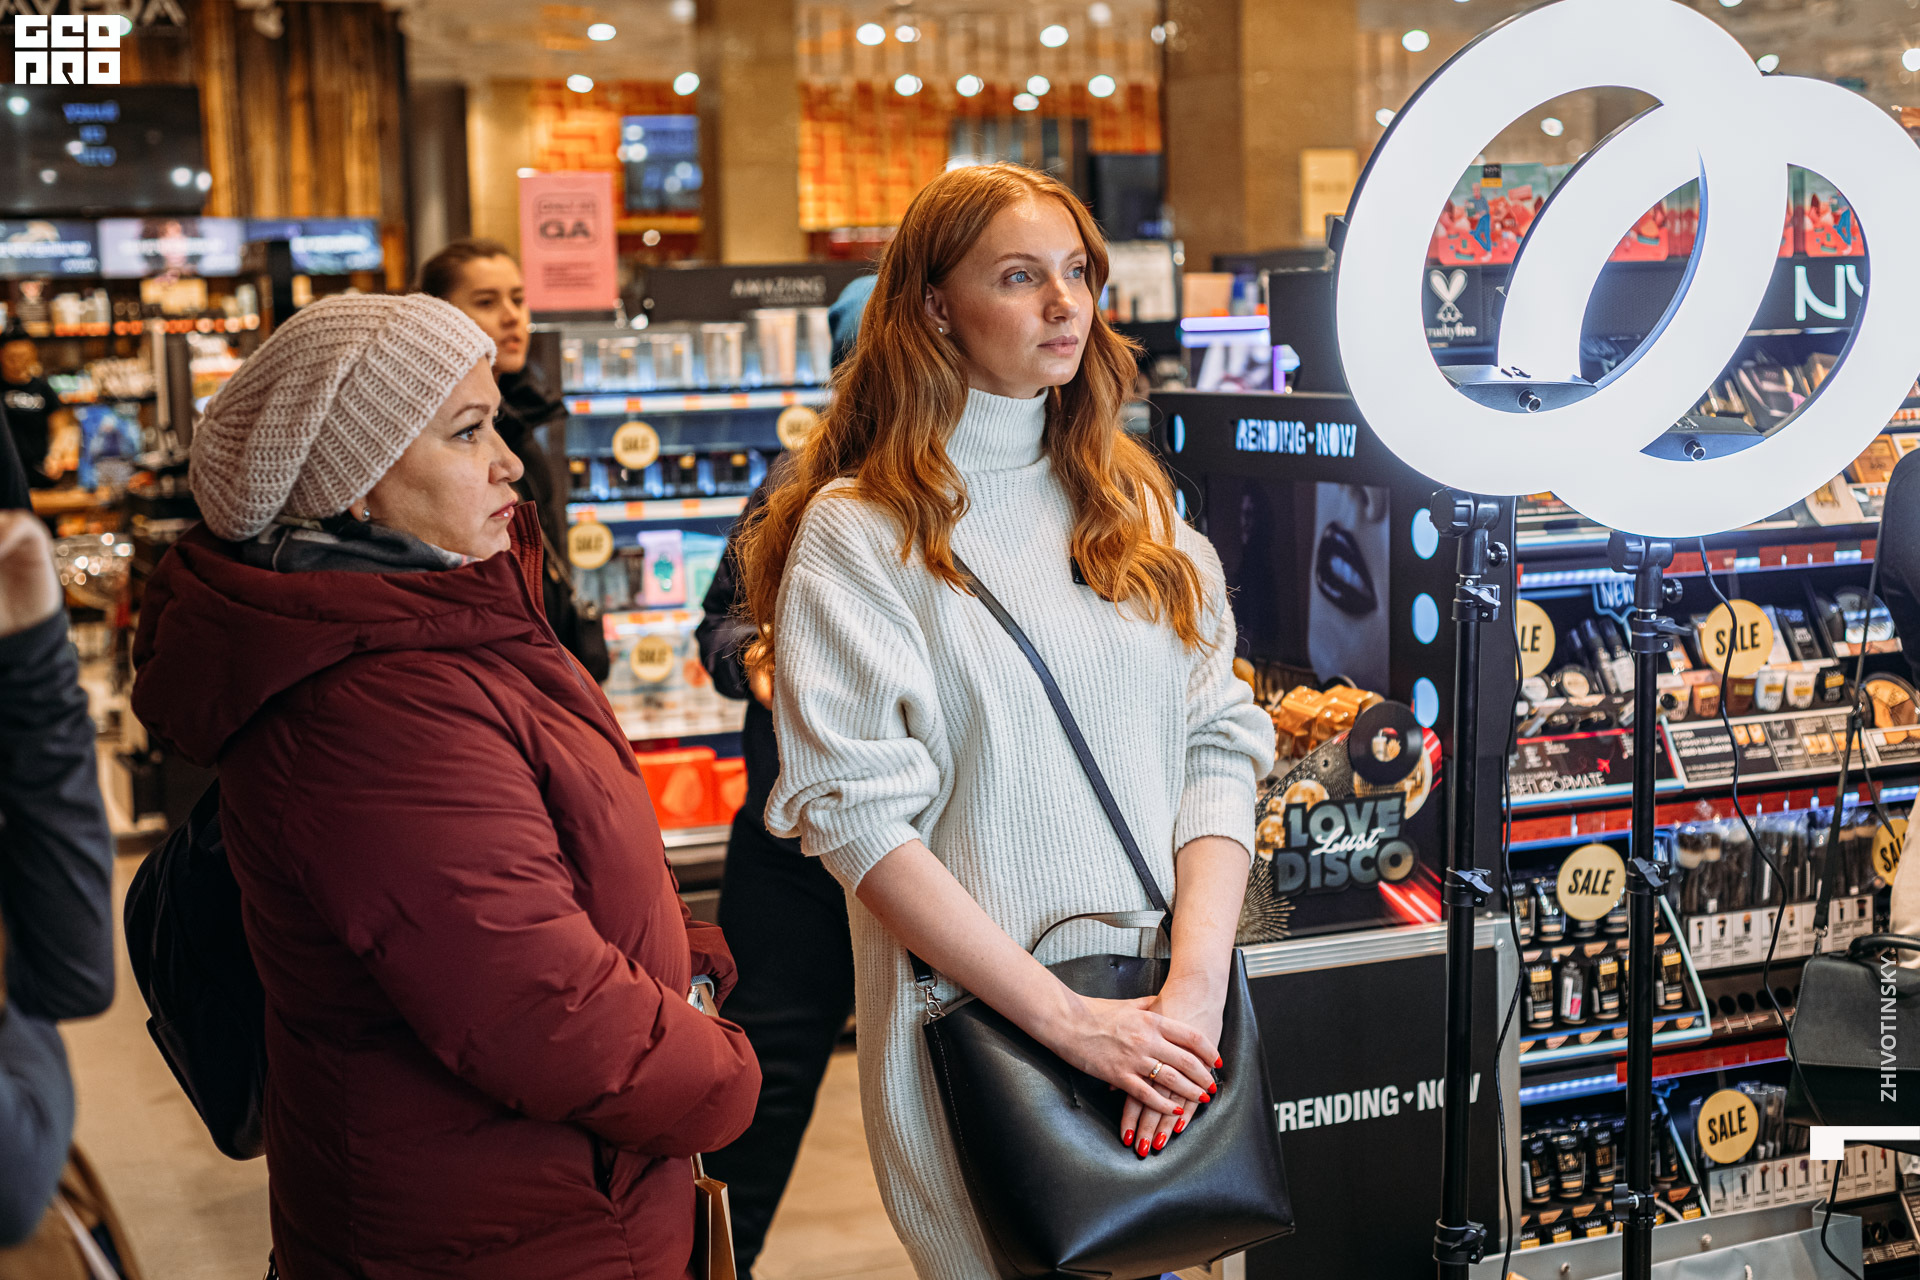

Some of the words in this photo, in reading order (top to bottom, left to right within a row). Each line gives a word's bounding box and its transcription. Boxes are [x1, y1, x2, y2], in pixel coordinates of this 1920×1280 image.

[1236, 418, 1307, 455] RENDING
[1316, 422, 1357, 458] NOW
[1521, 625, 1541, 652] LE
[1289, 797, 1401, 848] LOVE
[1311, 825, 1385, 856] Lust
[1276, 841, 1414, 892] DISCO
[1880, 833, 1905, 873] SAL
[1568, 868, 1616, 895] SALE
[1708, 1105, 1748, 1146] SALE
